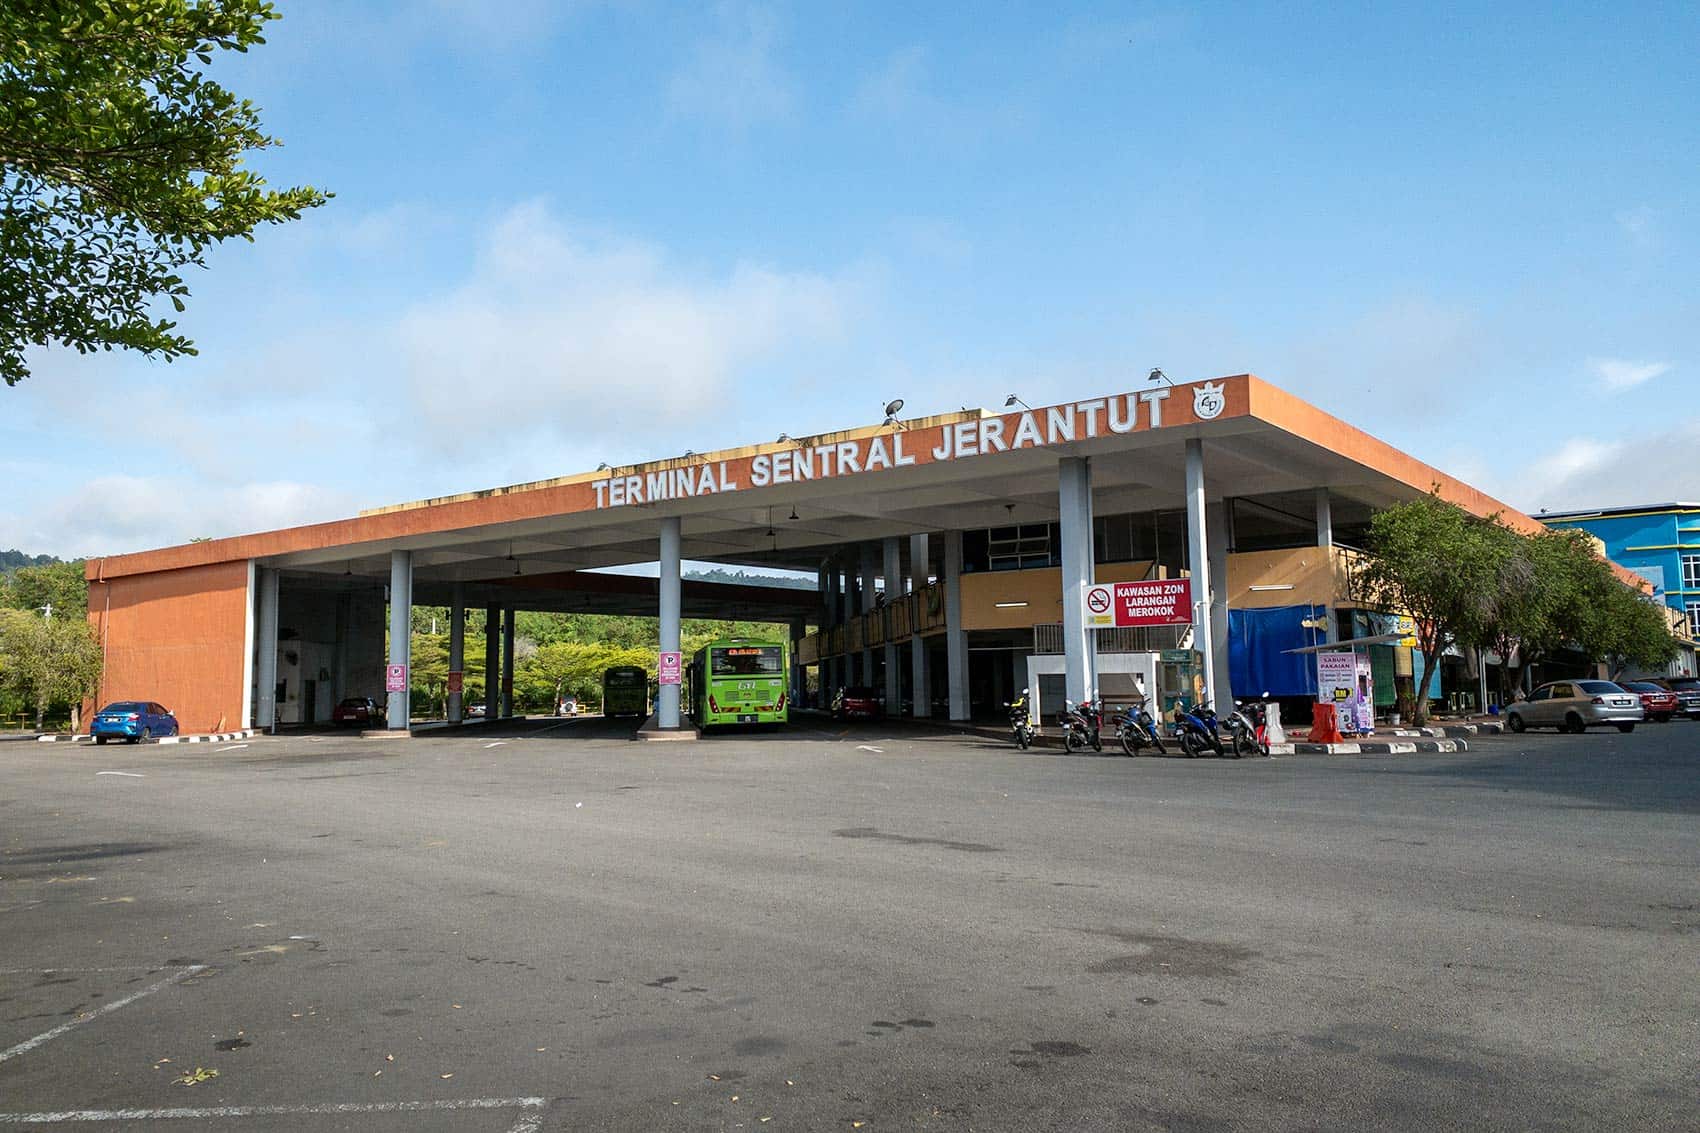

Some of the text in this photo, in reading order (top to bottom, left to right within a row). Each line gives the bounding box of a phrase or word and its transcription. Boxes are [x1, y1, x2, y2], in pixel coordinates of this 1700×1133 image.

[592, 461, 737, 509] TERMINAL
[751, 432, 916, 488] SENTRAL
[932, 387, 1171, 462] JERANTUT
[1117, 584, 1185, 598] KAWASAN ZON
[1125, 596, 1176, 607] LARANGAN
[1128, 606, 1175, 617] MEROKOK
